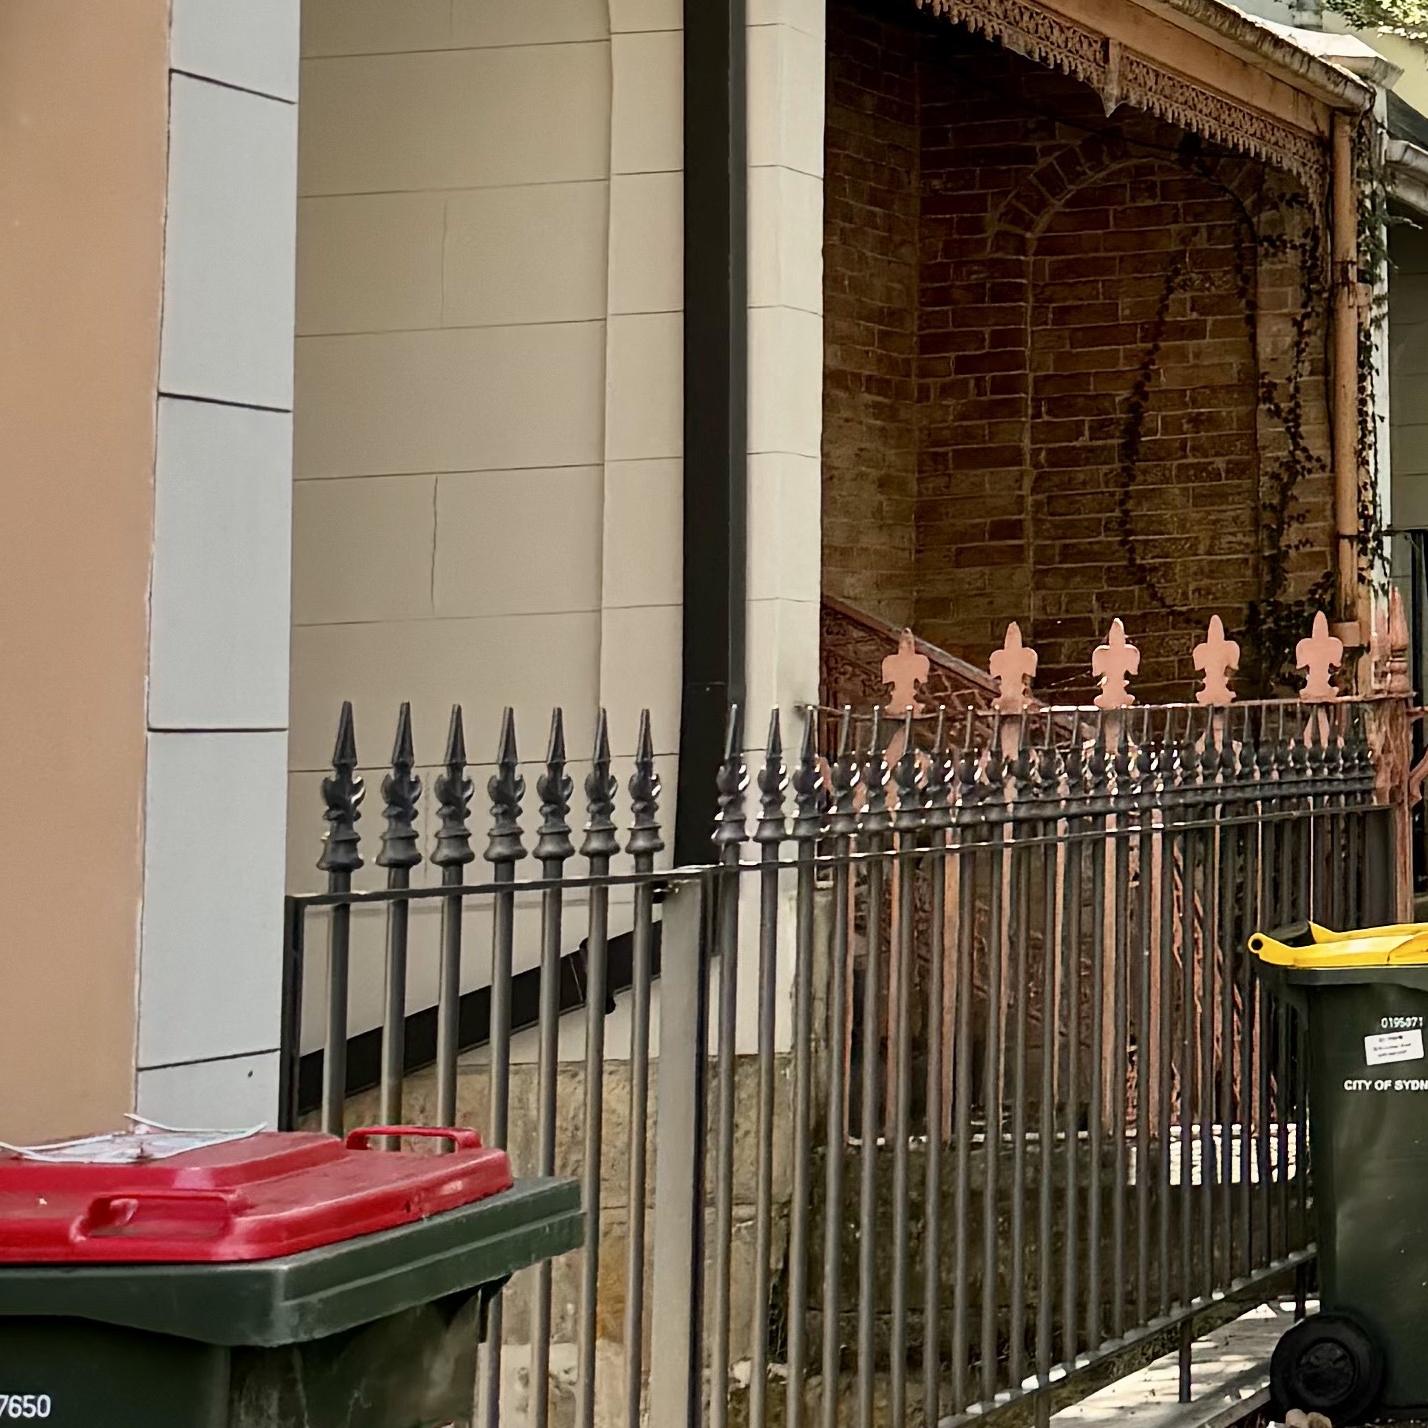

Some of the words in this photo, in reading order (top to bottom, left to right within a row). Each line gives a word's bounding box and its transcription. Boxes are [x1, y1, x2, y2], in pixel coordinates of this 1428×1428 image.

[1343, 1079, 1372, 1091] CITY
[1374, 1079, 1392, 1091] OF
[0, 1394, 51, 1419] 7650
